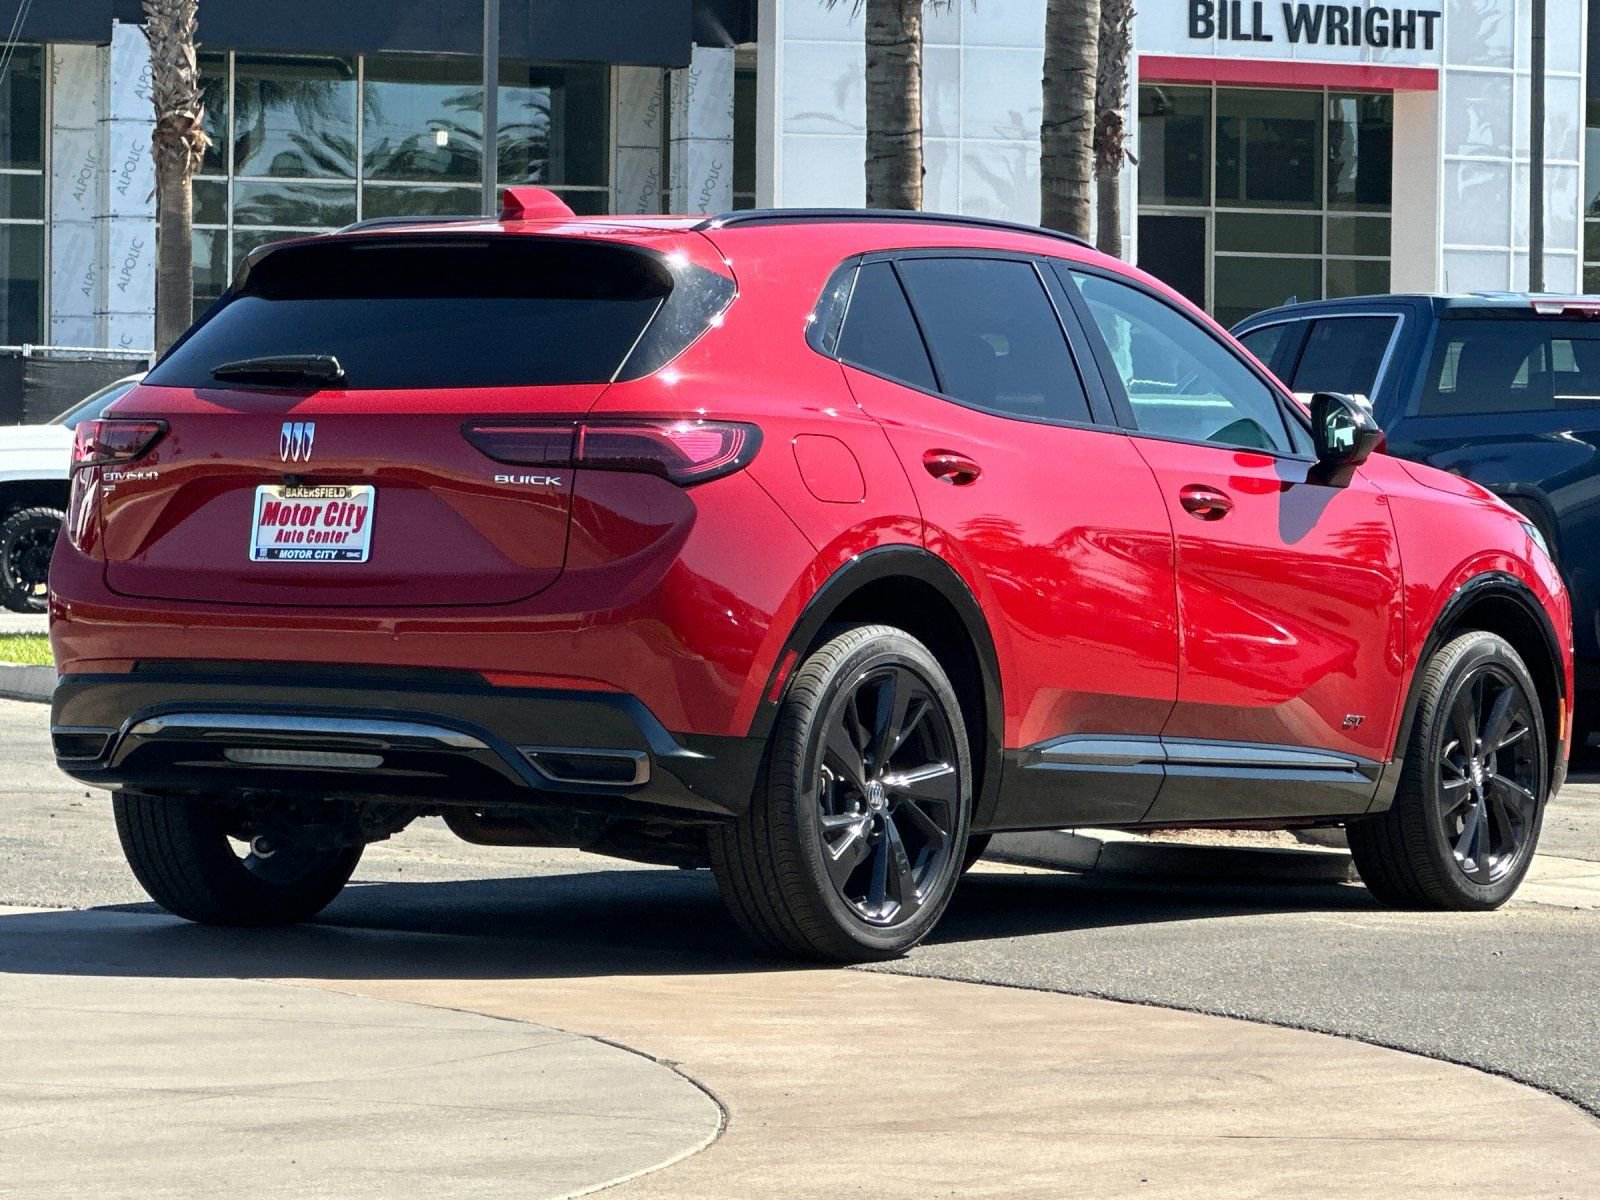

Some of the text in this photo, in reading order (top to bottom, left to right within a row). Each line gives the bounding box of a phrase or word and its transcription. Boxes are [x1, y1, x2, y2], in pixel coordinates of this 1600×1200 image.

[1189, 0, 1441, 50] BILL WRIGHT
[117, 139, 144, 196] ALPOLIC
[698, 159, 723, 215] ALPOLIC
[117, 238, 144, 293] ALPOLIC
[285, 487, 346, 498] BAKERSFIELD
[494, 474, 562, 485] BUICK
[260, 502, 368, 533] Motor City
[275, 529, 349, 544] Auto Center
[279, 550, 311, 559] MOTOR
[314, 550, 338, 559] CITY
